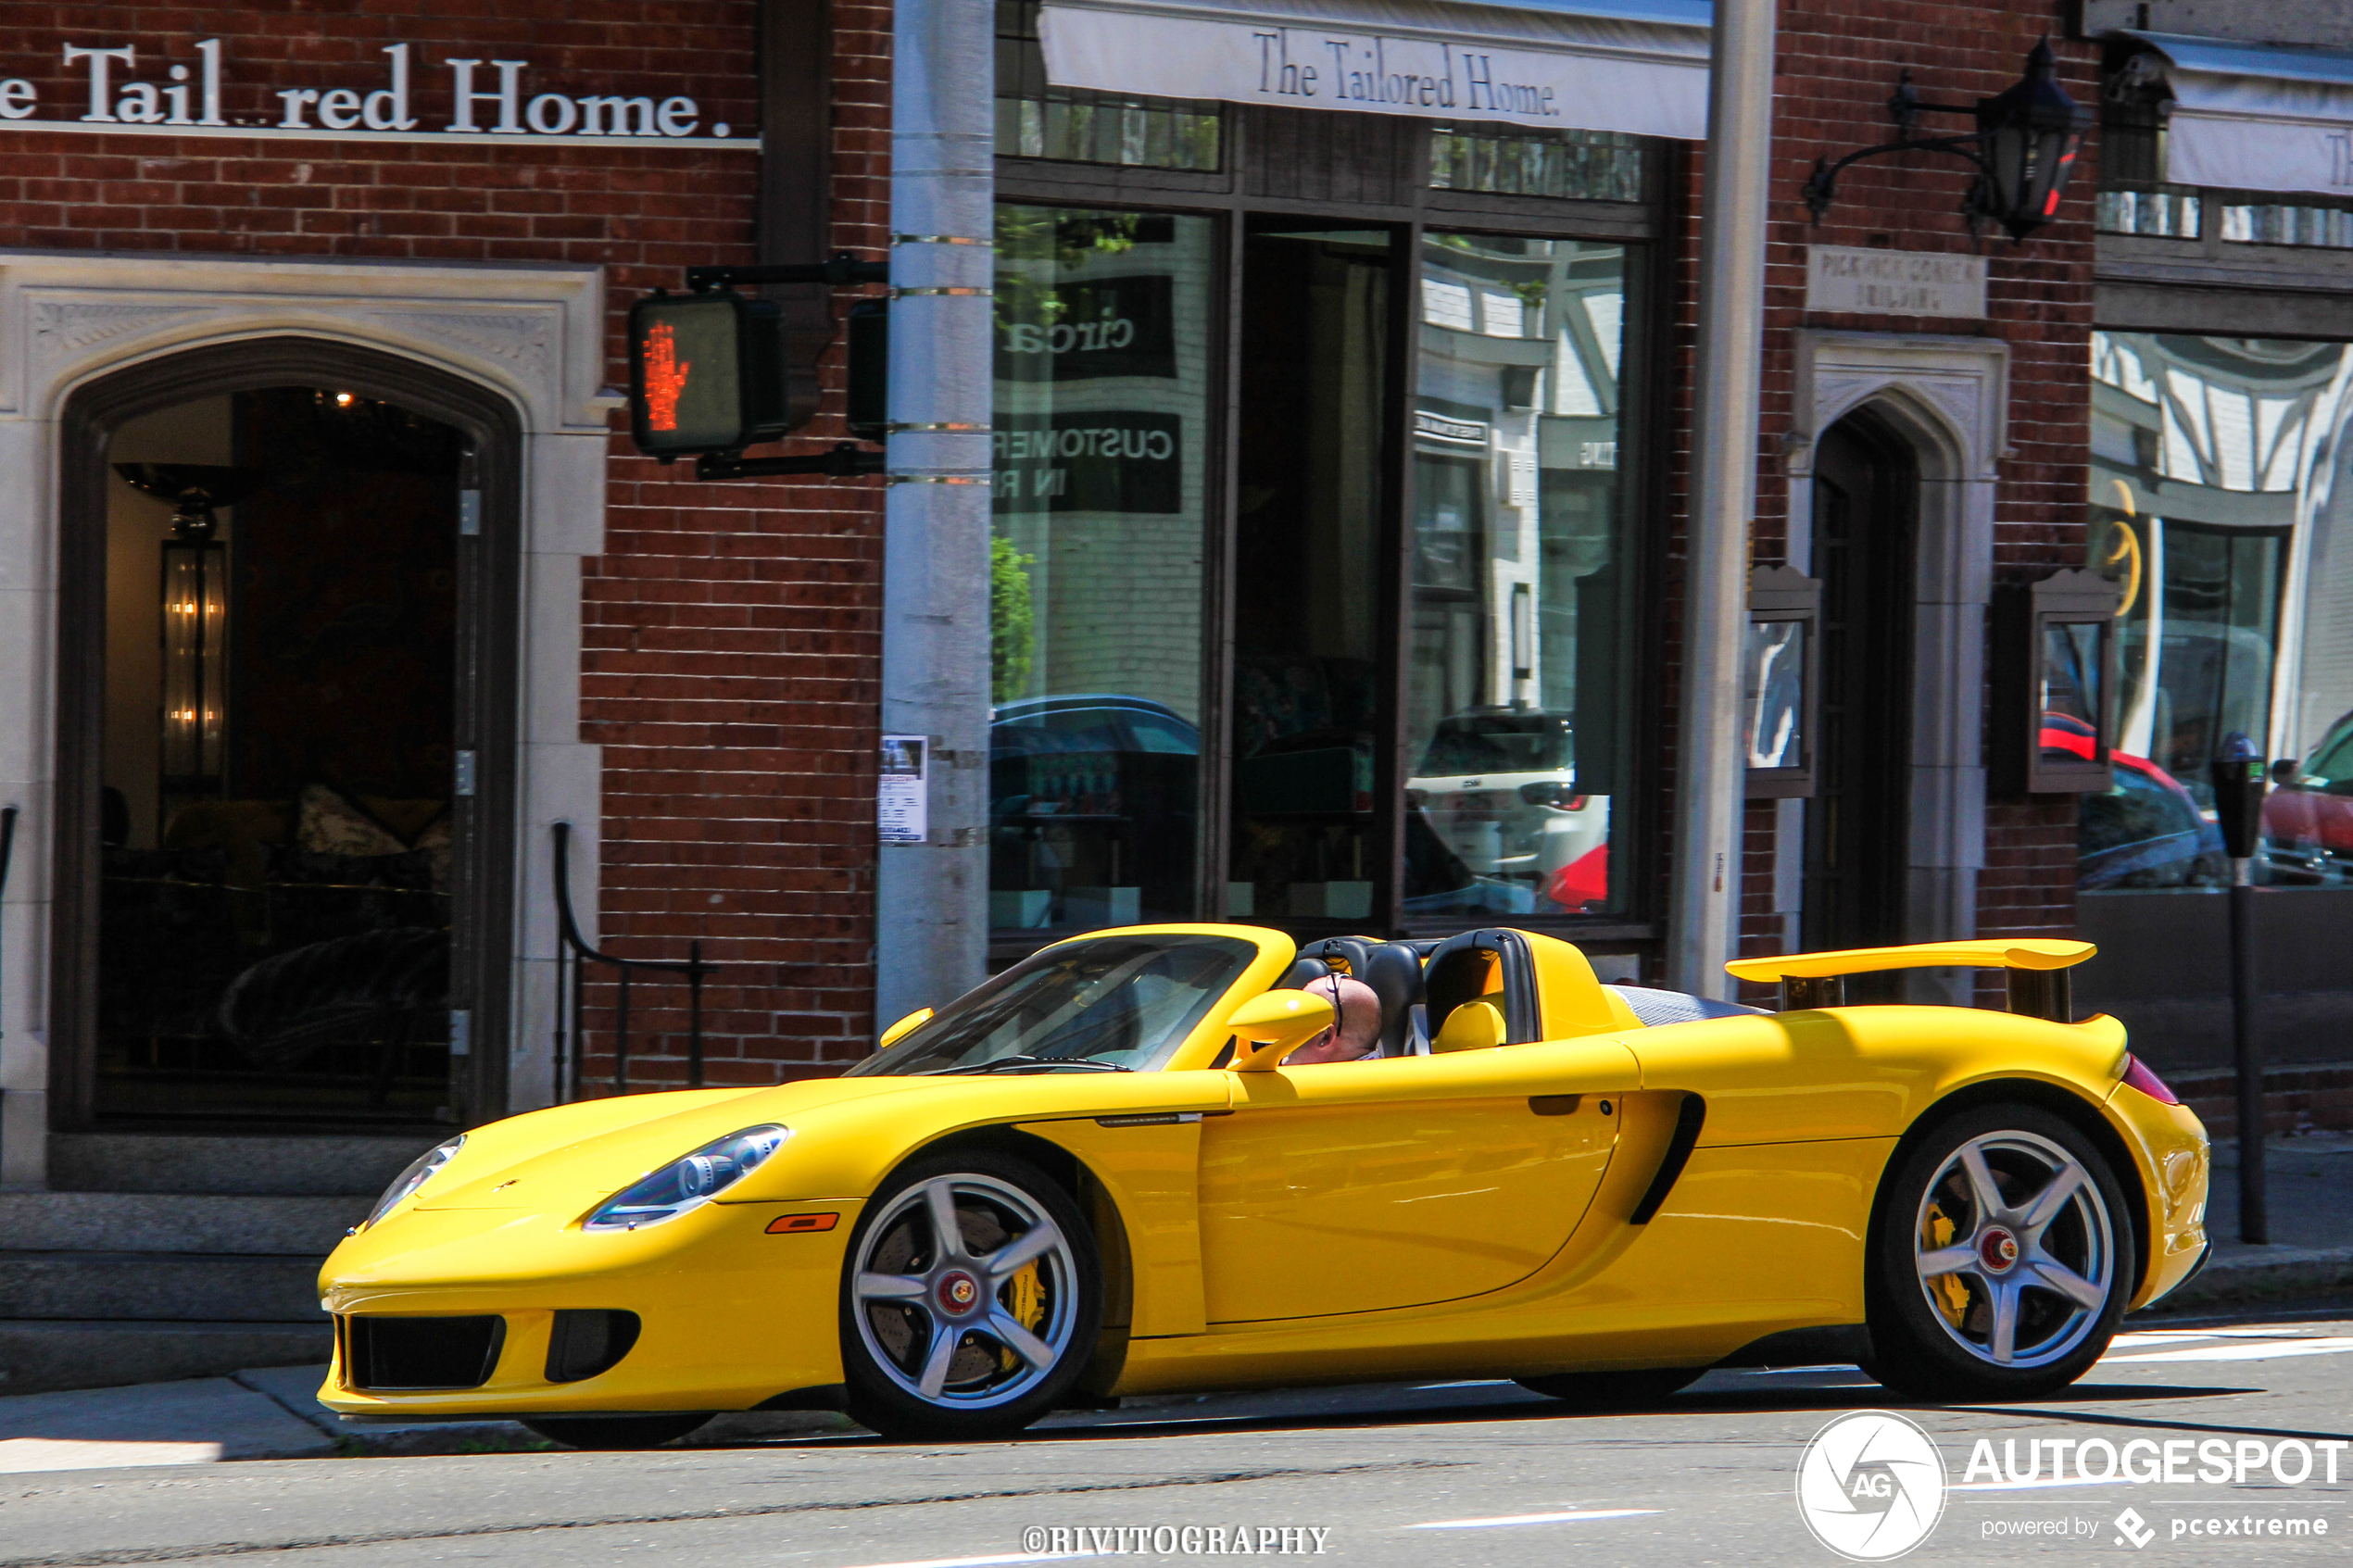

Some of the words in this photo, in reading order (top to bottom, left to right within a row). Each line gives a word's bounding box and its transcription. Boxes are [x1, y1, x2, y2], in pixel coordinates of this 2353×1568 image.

[445, 57, 731, 137] Home.
[1253, 28, 1318, 96] The
[1326, 36, 1456, 108] Tailored
[1463, 54, 1560, 117] Home.
